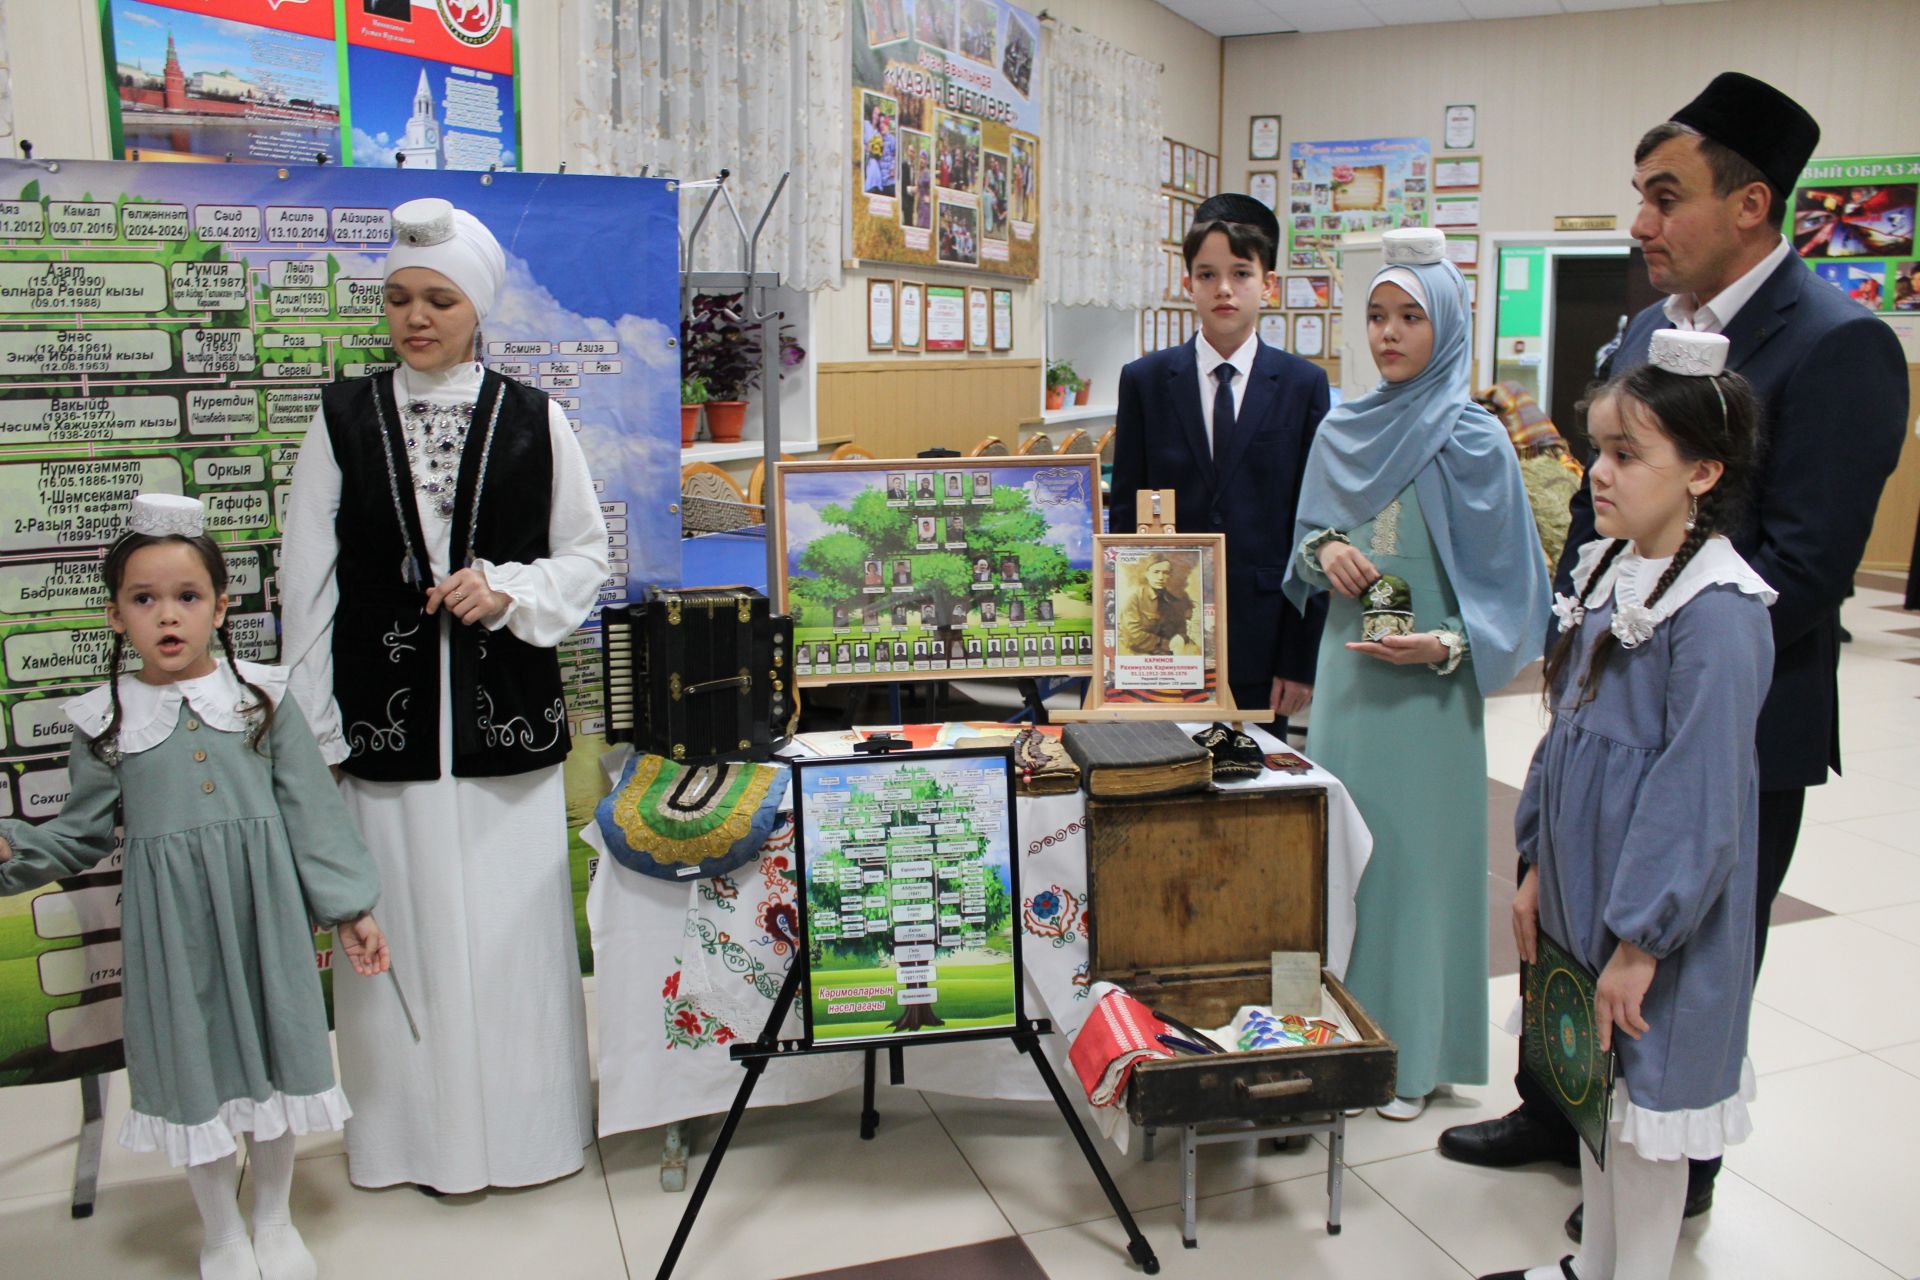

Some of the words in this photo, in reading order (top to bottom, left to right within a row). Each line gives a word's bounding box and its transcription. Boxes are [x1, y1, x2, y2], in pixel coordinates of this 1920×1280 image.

[1845, 162, 1904, 178] ОБРАЗ
[63, 204, 101, 217] Камал
[213, 210, 243, 222] Сәид
[280, 210, 314, 222] Асилә
[340, 212, 385, 225] Айзирәк
[50, 222, 118, 236] (09.07.2016)
[125, 224, 188, 239] (2024-2024)
[198, 226, 260, 240] (26.04.2012)
[267, 226, 328, 240] (13.10.2014)
[46, 262, 85, 279] Азат
[186, 262, 228, 279] Румия
[28, 276, 106, 289] (15.05.1990)
[172, 278, 245, 290] (04.12.1987)
[283, 275, 314, 286] (1990)
[0, 284, 54, 300] өлнара
[58, 283, 101, 297] Равил
[106, 287, 144, 297] кызы
[57, 331, 93, 342] Әнәс
[195, 329, 241, 344] Фәрит
[283, 335, 305, 346] Роза
[35, 343, 113, 354] (12.04.1961)
[202, 342, 238, 353] (1963)
[504, 343, 542, 354] Ясминә
[576, 342, 605, 353] Азизә
[117, 352, 154, 360] кызы
[41, 363, 109, 373] (12.08.1963)
[203, 361, 240, 373] (1968)
[278, 364, 312, 377] Сергей
[51, 399, 109, 414] Вакыйф
[193, 394, 254, 410] Нуретдин
[42, 410, 116, 422] (1936-1977)
[140, 418, 178, 429] кызы
[48, 428, 114, 440] (1938-2012)
[40, 461, 141, 479] Нурмөхәммәт
[207, 463, 252, 479] Оркыя
[38, 474, 144, 490] (16.05.1886-1970)
[48, 504, 80, 516] (1911
[84, 502, 133, 514] вафат)
[209, 495, 263, 513] Гафифә
[15, 518, 72, 533] 2-Разыя
[76, 514, 122, 532] Зариф
[20, 584, 106, 600] Бәдрикамал
[22, 653, 98, 670] Хамдениса
